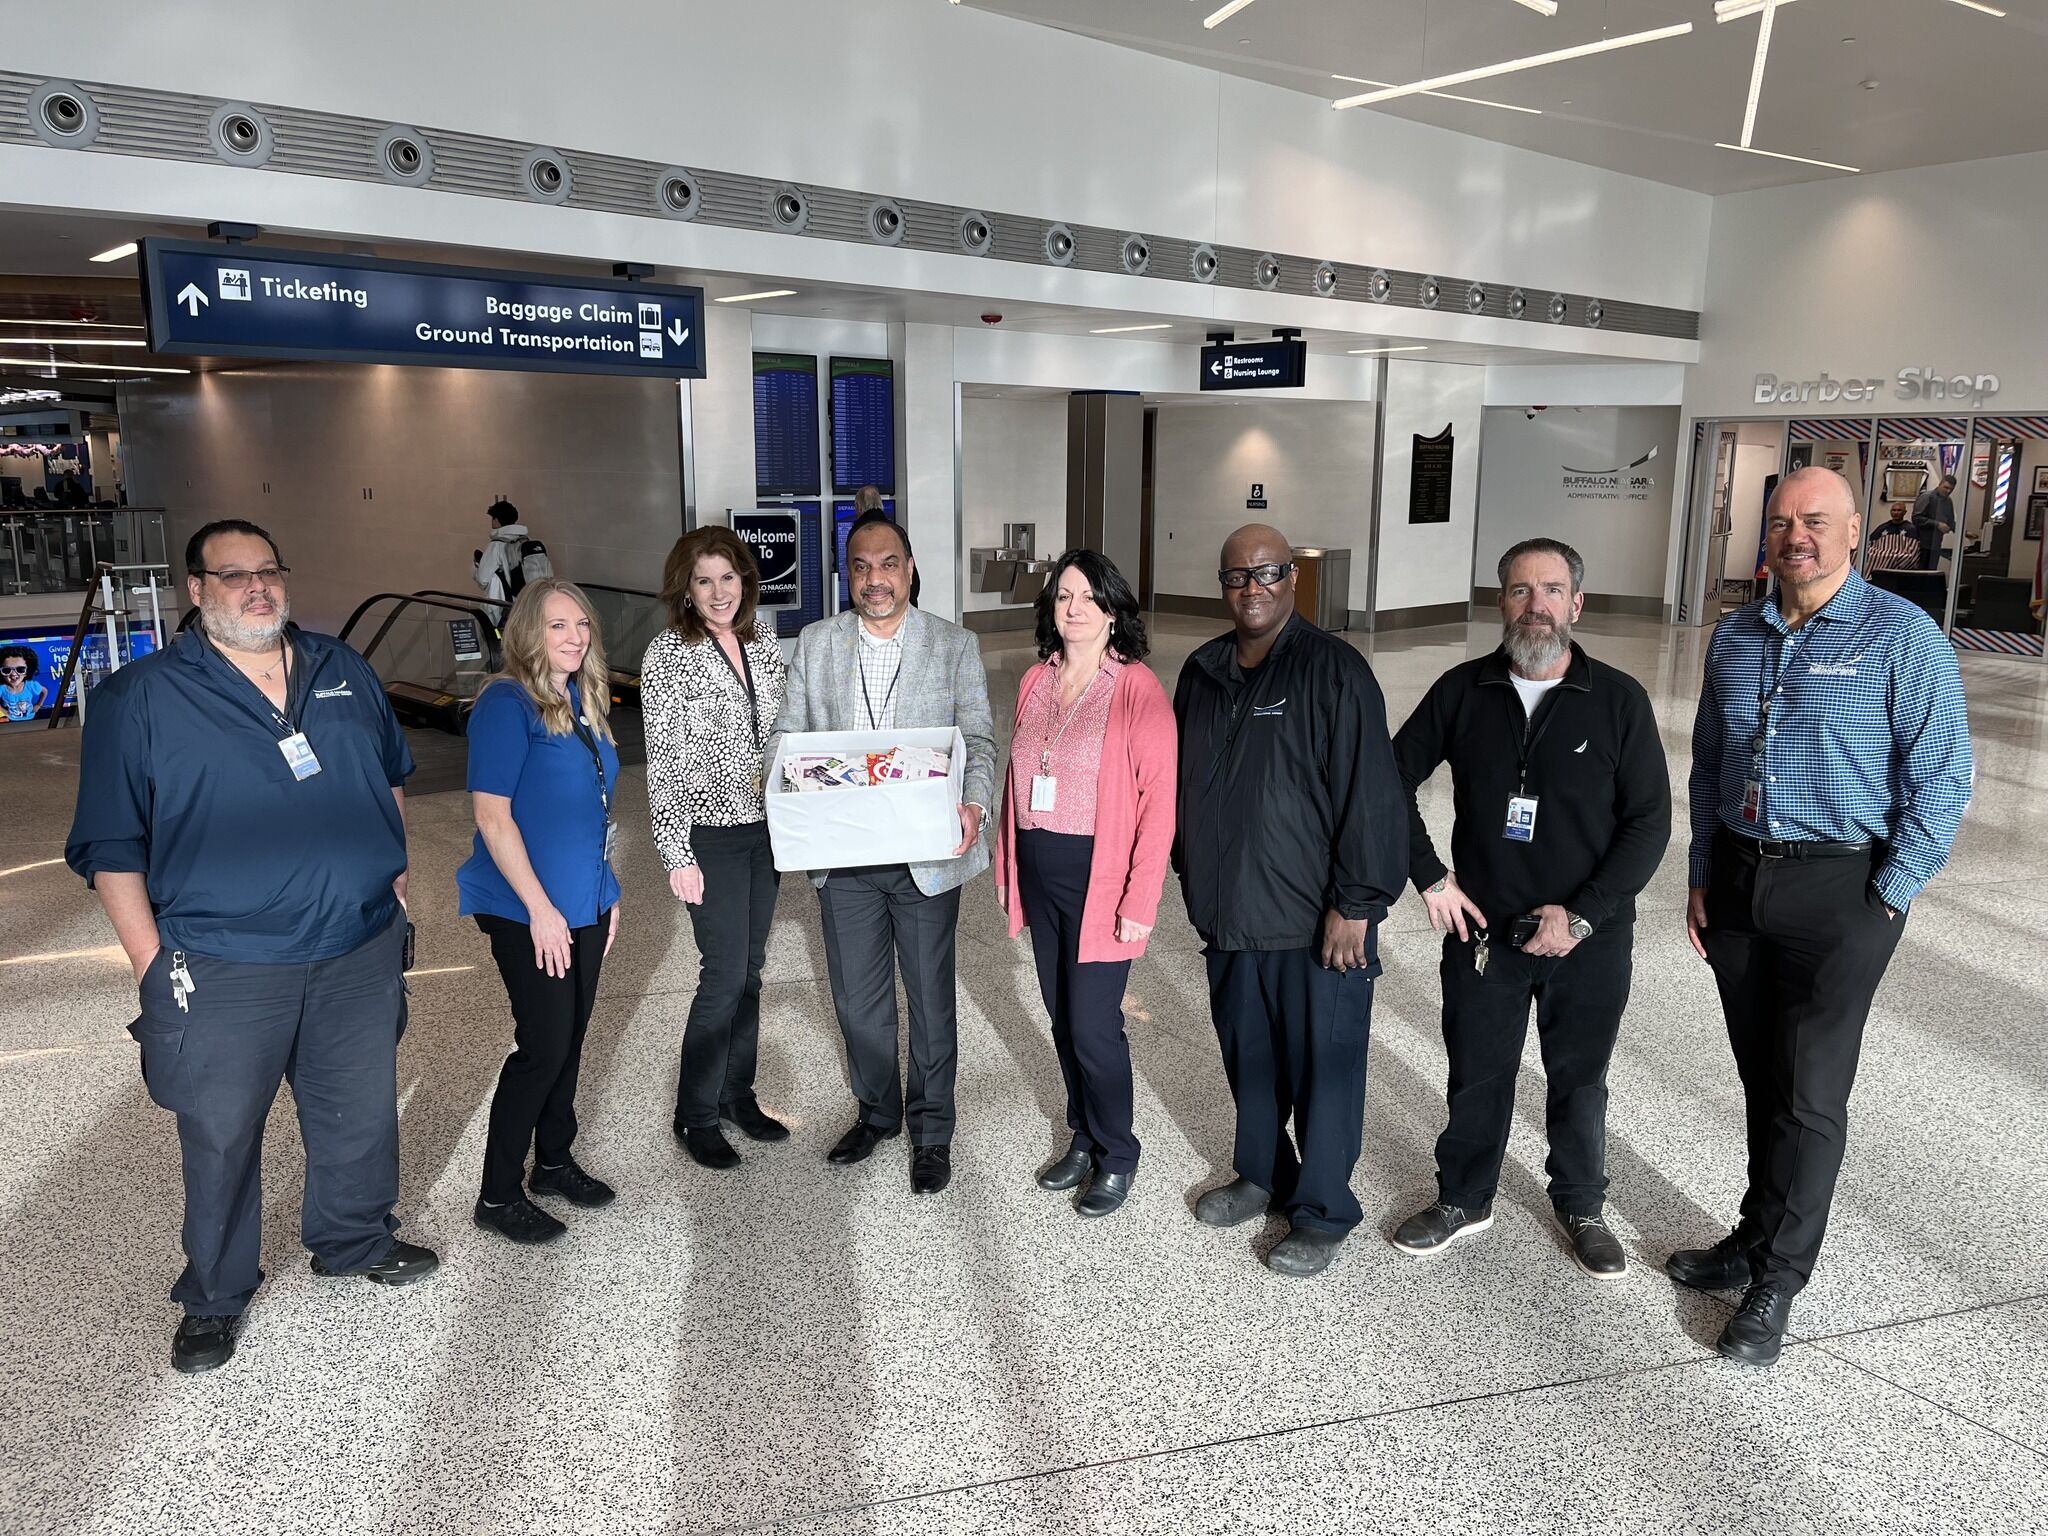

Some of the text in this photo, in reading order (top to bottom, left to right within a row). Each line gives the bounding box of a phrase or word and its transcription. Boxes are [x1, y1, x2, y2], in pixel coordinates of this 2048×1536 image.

[260, 277, 367, 308] Ticketing
[486, 297, 633, 324] Baggage Claim
[416, 323, 634, 353] Ground Transportation
[1233, 368, 1280, 377] Nursing Lounge
[1754, 367, 2000, 408] Barber Shop
[1563, 476, 1607, 485] BUFFALO
[736, 528, 795, 543] Welcome
[758, 545, 773, 559] To
[48, 645, 71, 656] Giving
